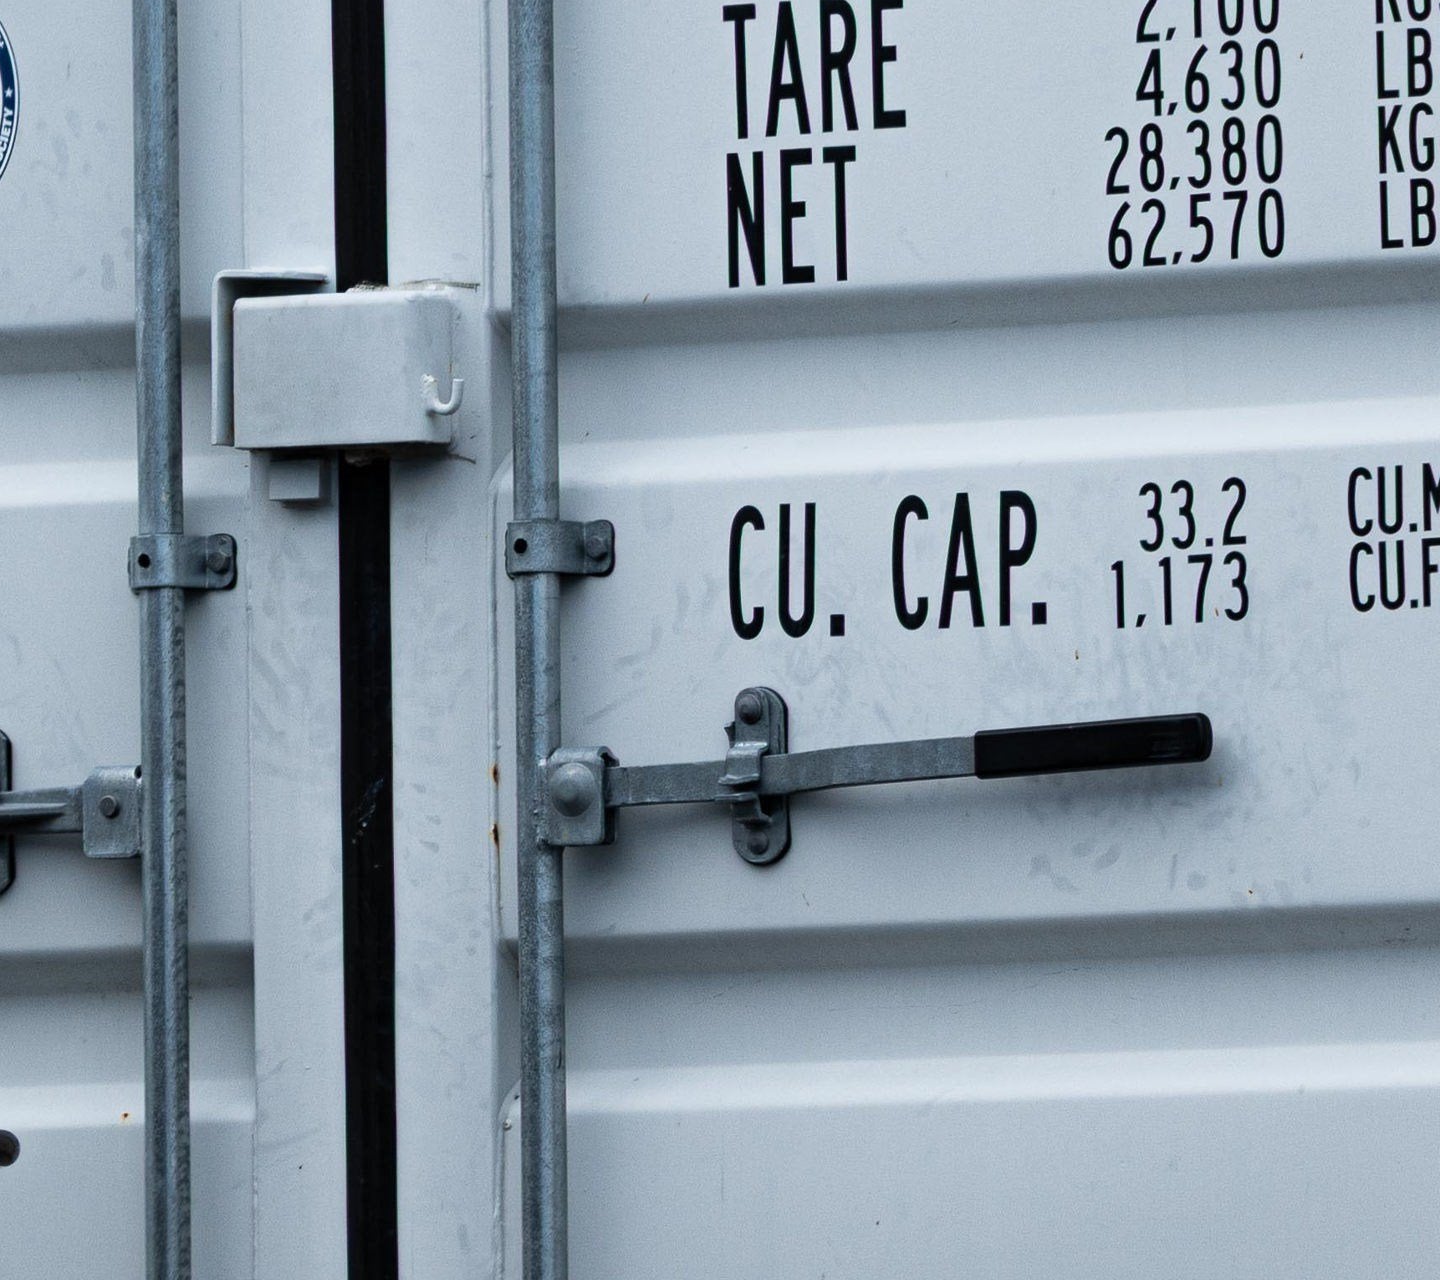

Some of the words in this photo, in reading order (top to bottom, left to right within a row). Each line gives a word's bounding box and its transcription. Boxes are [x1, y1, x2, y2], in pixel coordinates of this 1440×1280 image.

[1135, 39, 1282, 117] 4,630
[725, 145, 857, 289] NET
[1104, 114, 1283, 196] 28,380
[1107, 188, 1284, 270] 62,570
[728, 502, 846, 641] CU.
[891, 490, 1047, 630] CAP.
[1138, 476, 1248, 552] 33.2
[1110, 550, 1250, 629] 1,173
